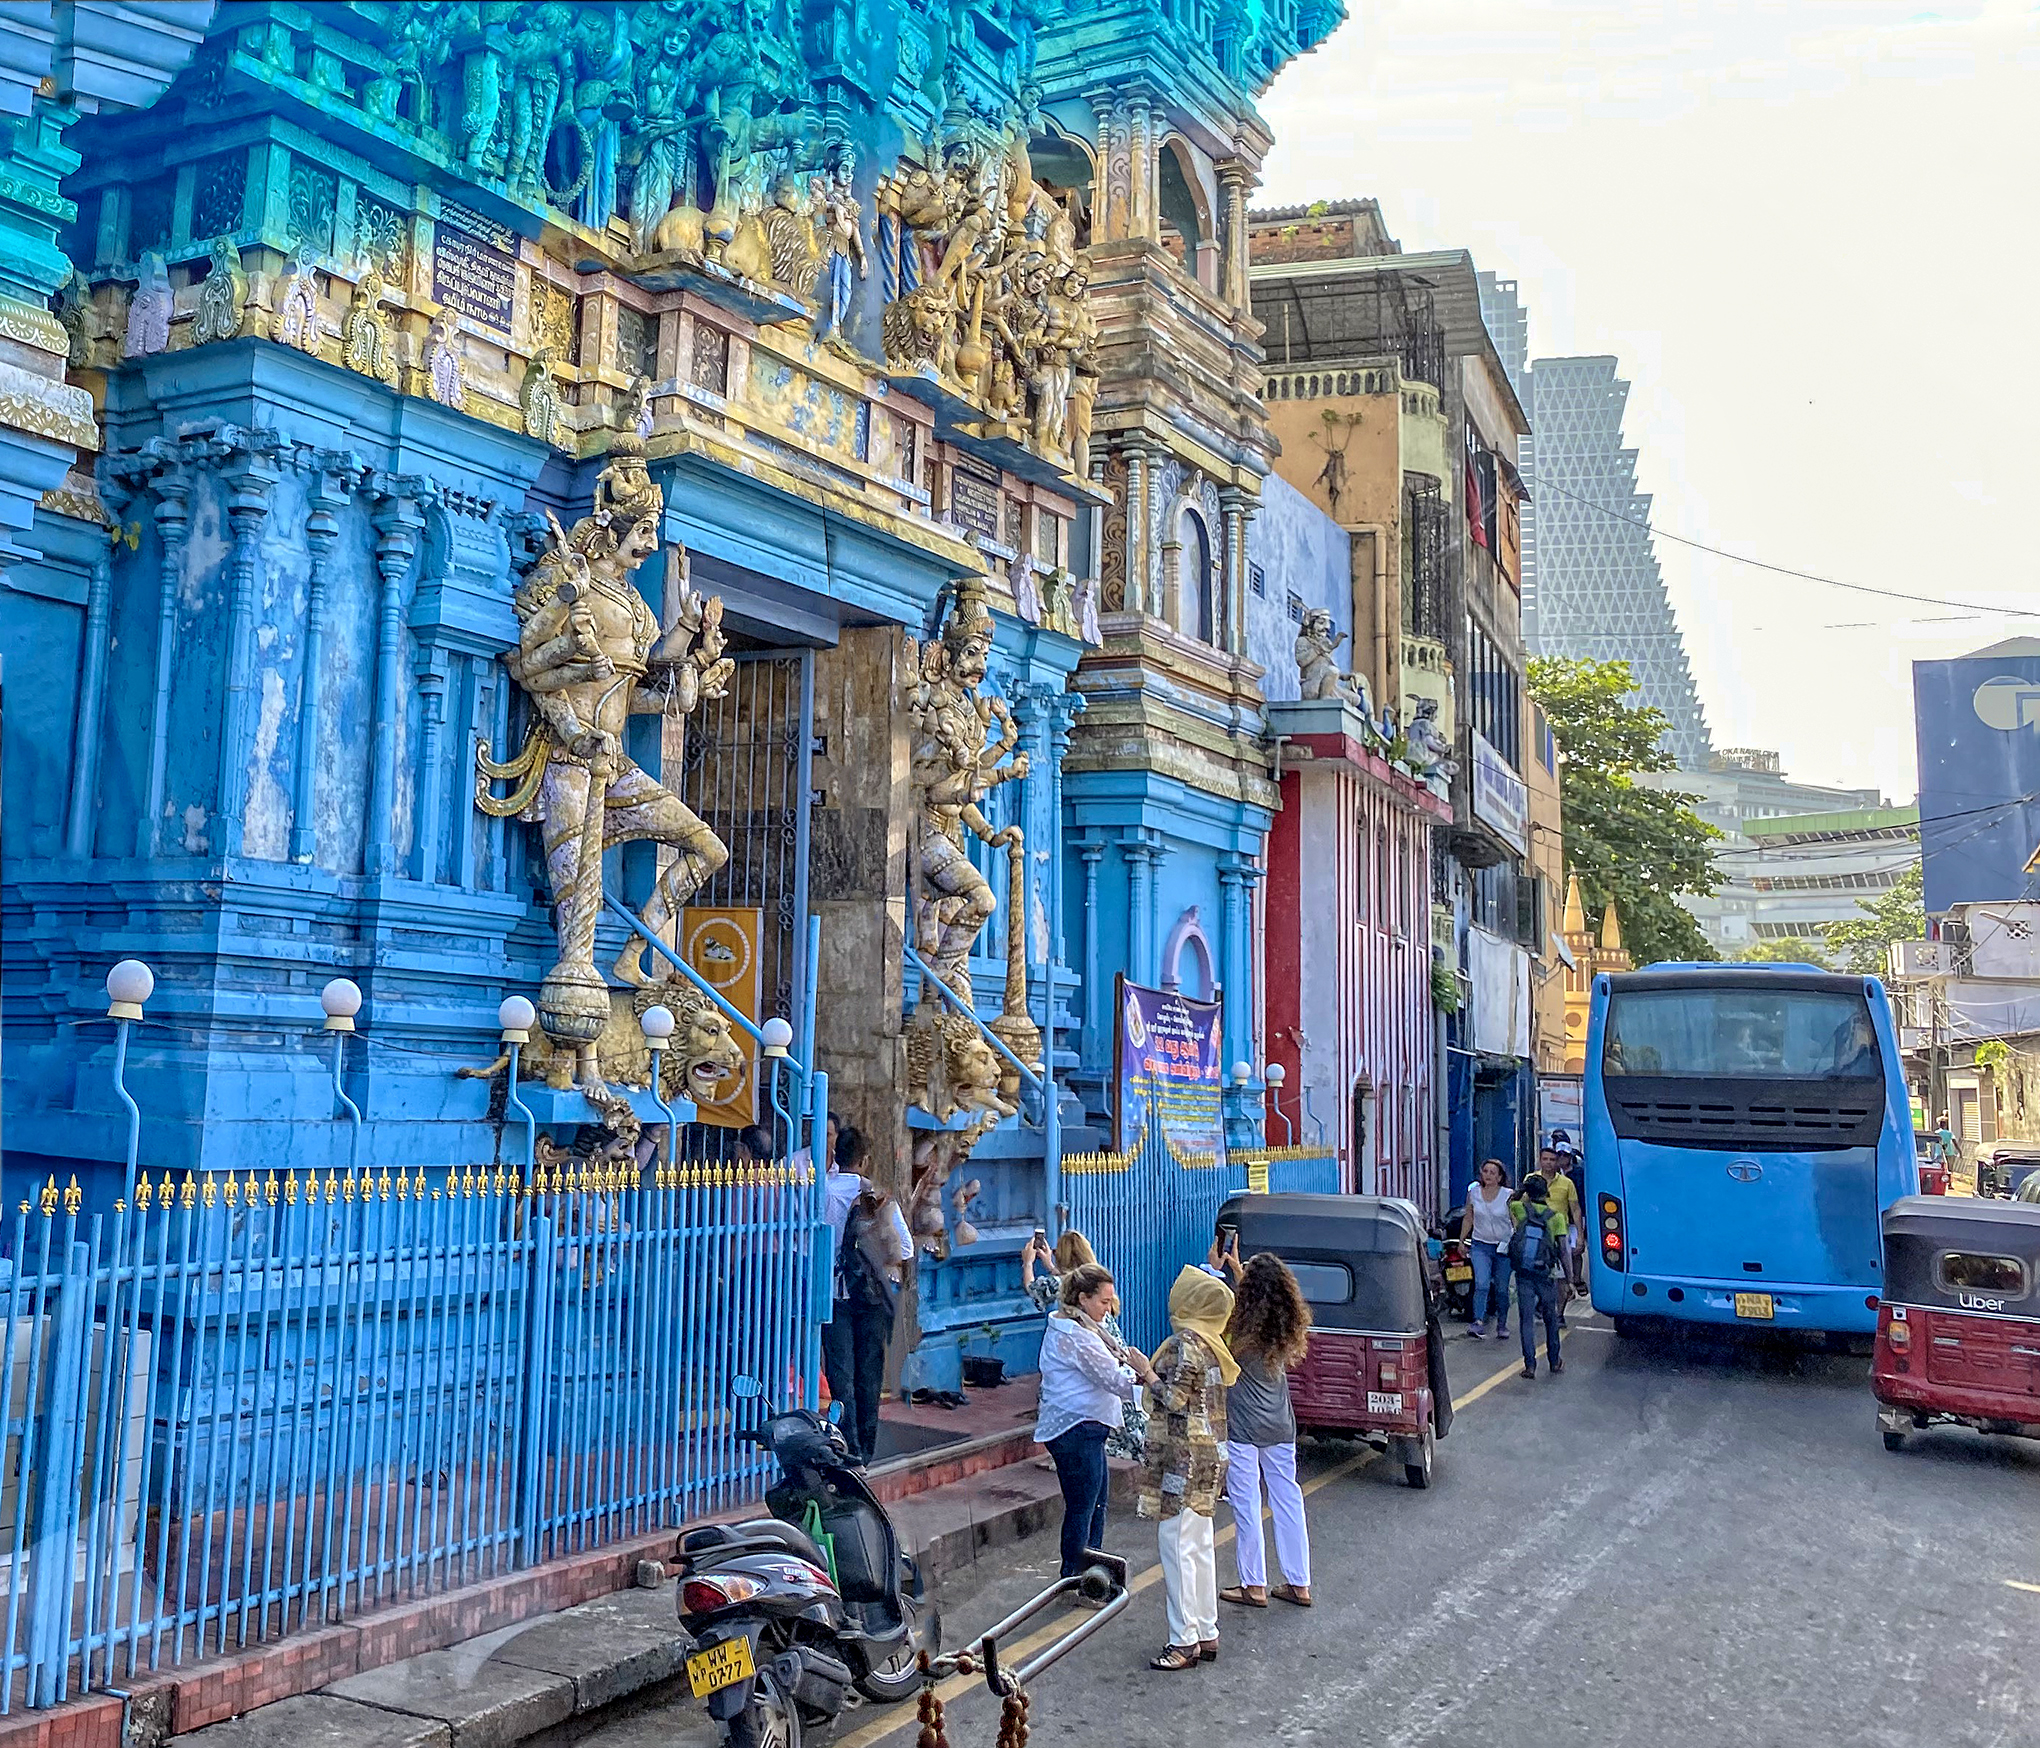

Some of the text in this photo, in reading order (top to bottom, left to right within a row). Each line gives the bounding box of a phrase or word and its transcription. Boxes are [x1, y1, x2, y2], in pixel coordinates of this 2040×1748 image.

[1959, 1292, 2006, 1311] Uber
[707, 1645, 727, 1667] WW
[709, 1659, 742, 1688] 0777
